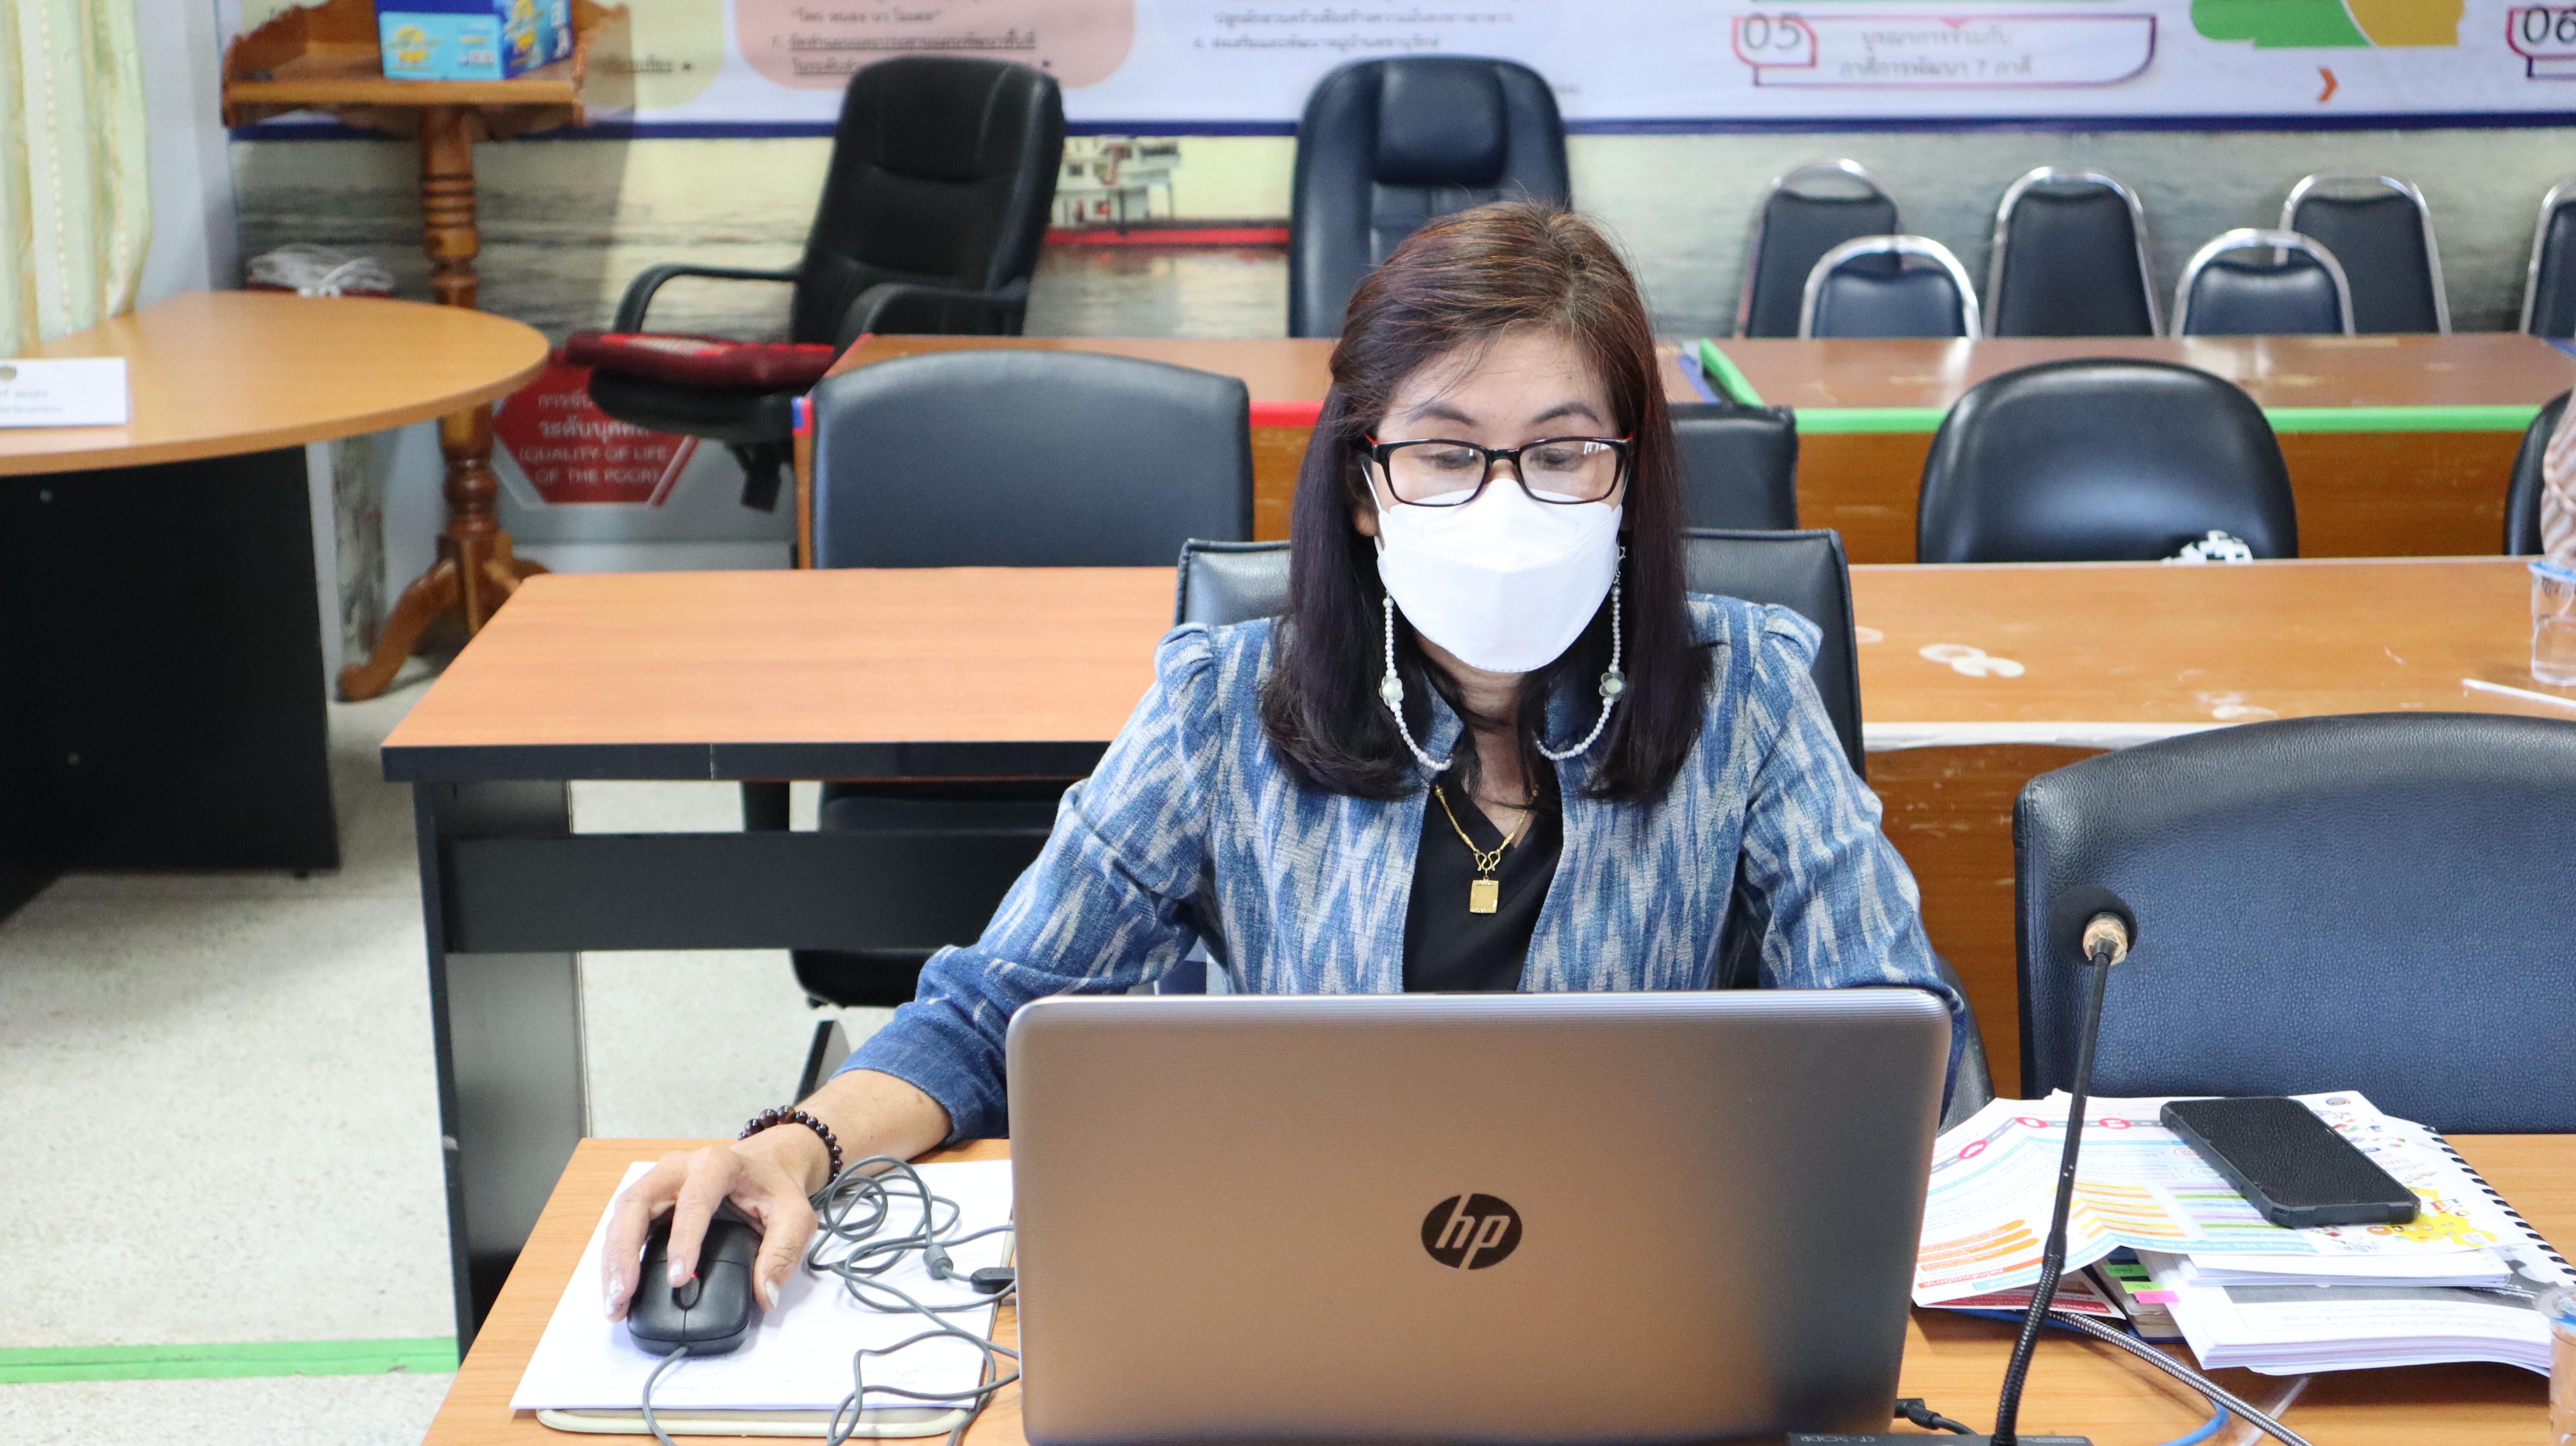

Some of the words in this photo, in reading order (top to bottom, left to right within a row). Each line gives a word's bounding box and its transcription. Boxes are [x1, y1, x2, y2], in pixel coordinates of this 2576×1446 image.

[1743, 12, 1802, 51] 05
[2524, 4, 2576, 44] 06
[604, 446, 630, 463] OF
[634, 446, 668, 463] LIFE
[535, 468, 561, 485] OF
[568, 467, 598, 484] THE
[1432, 1193, 1514, 1270] hp
